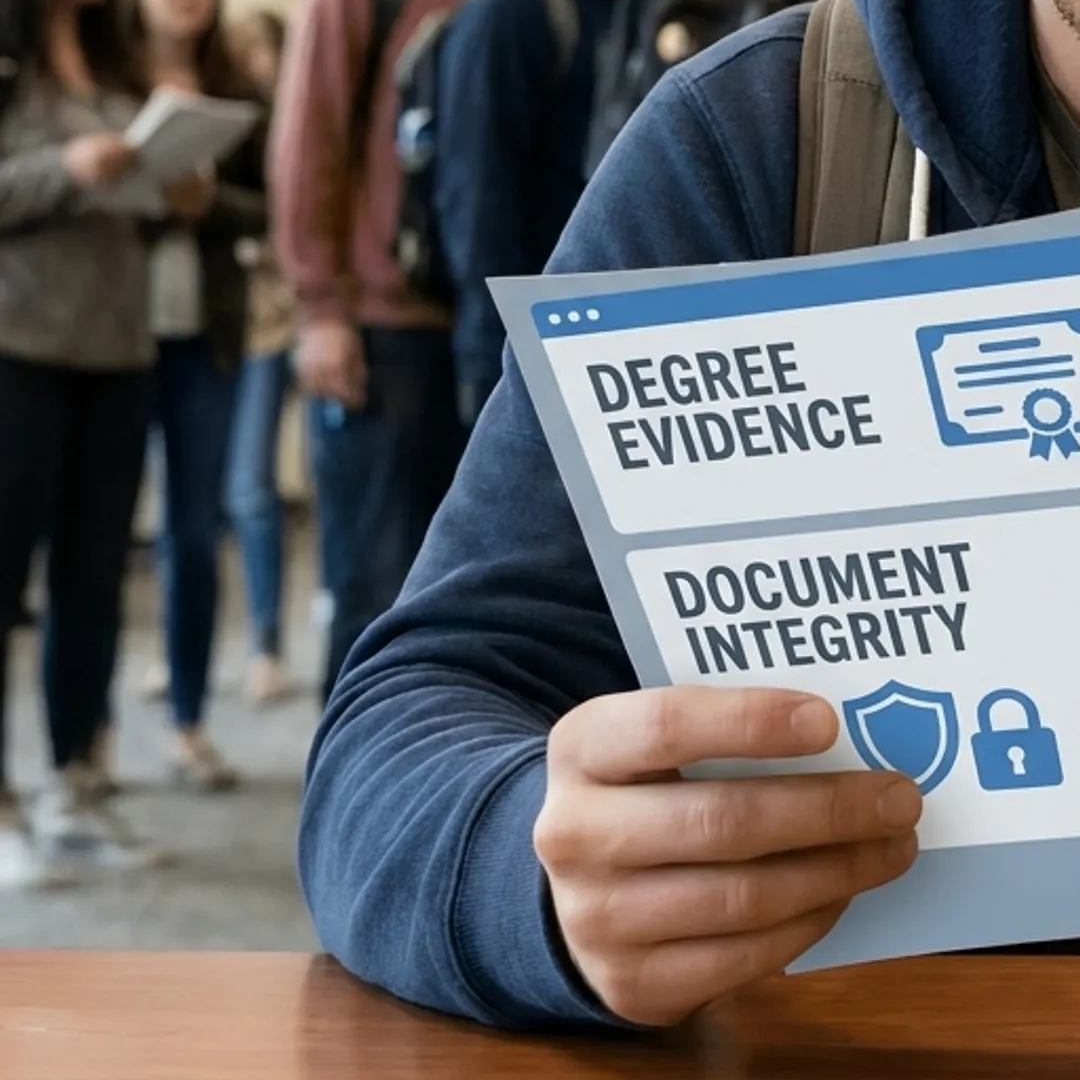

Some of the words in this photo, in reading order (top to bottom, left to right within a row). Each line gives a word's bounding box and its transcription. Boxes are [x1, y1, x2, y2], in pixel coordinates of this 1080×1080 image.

[587, 342, 807, 413] DEGREE
[607, 394, 882, 470] EVIDENCE
[663, 542, 972, 619] DOCUMENT
[685, 602, 967, 675] INTEGRITY
